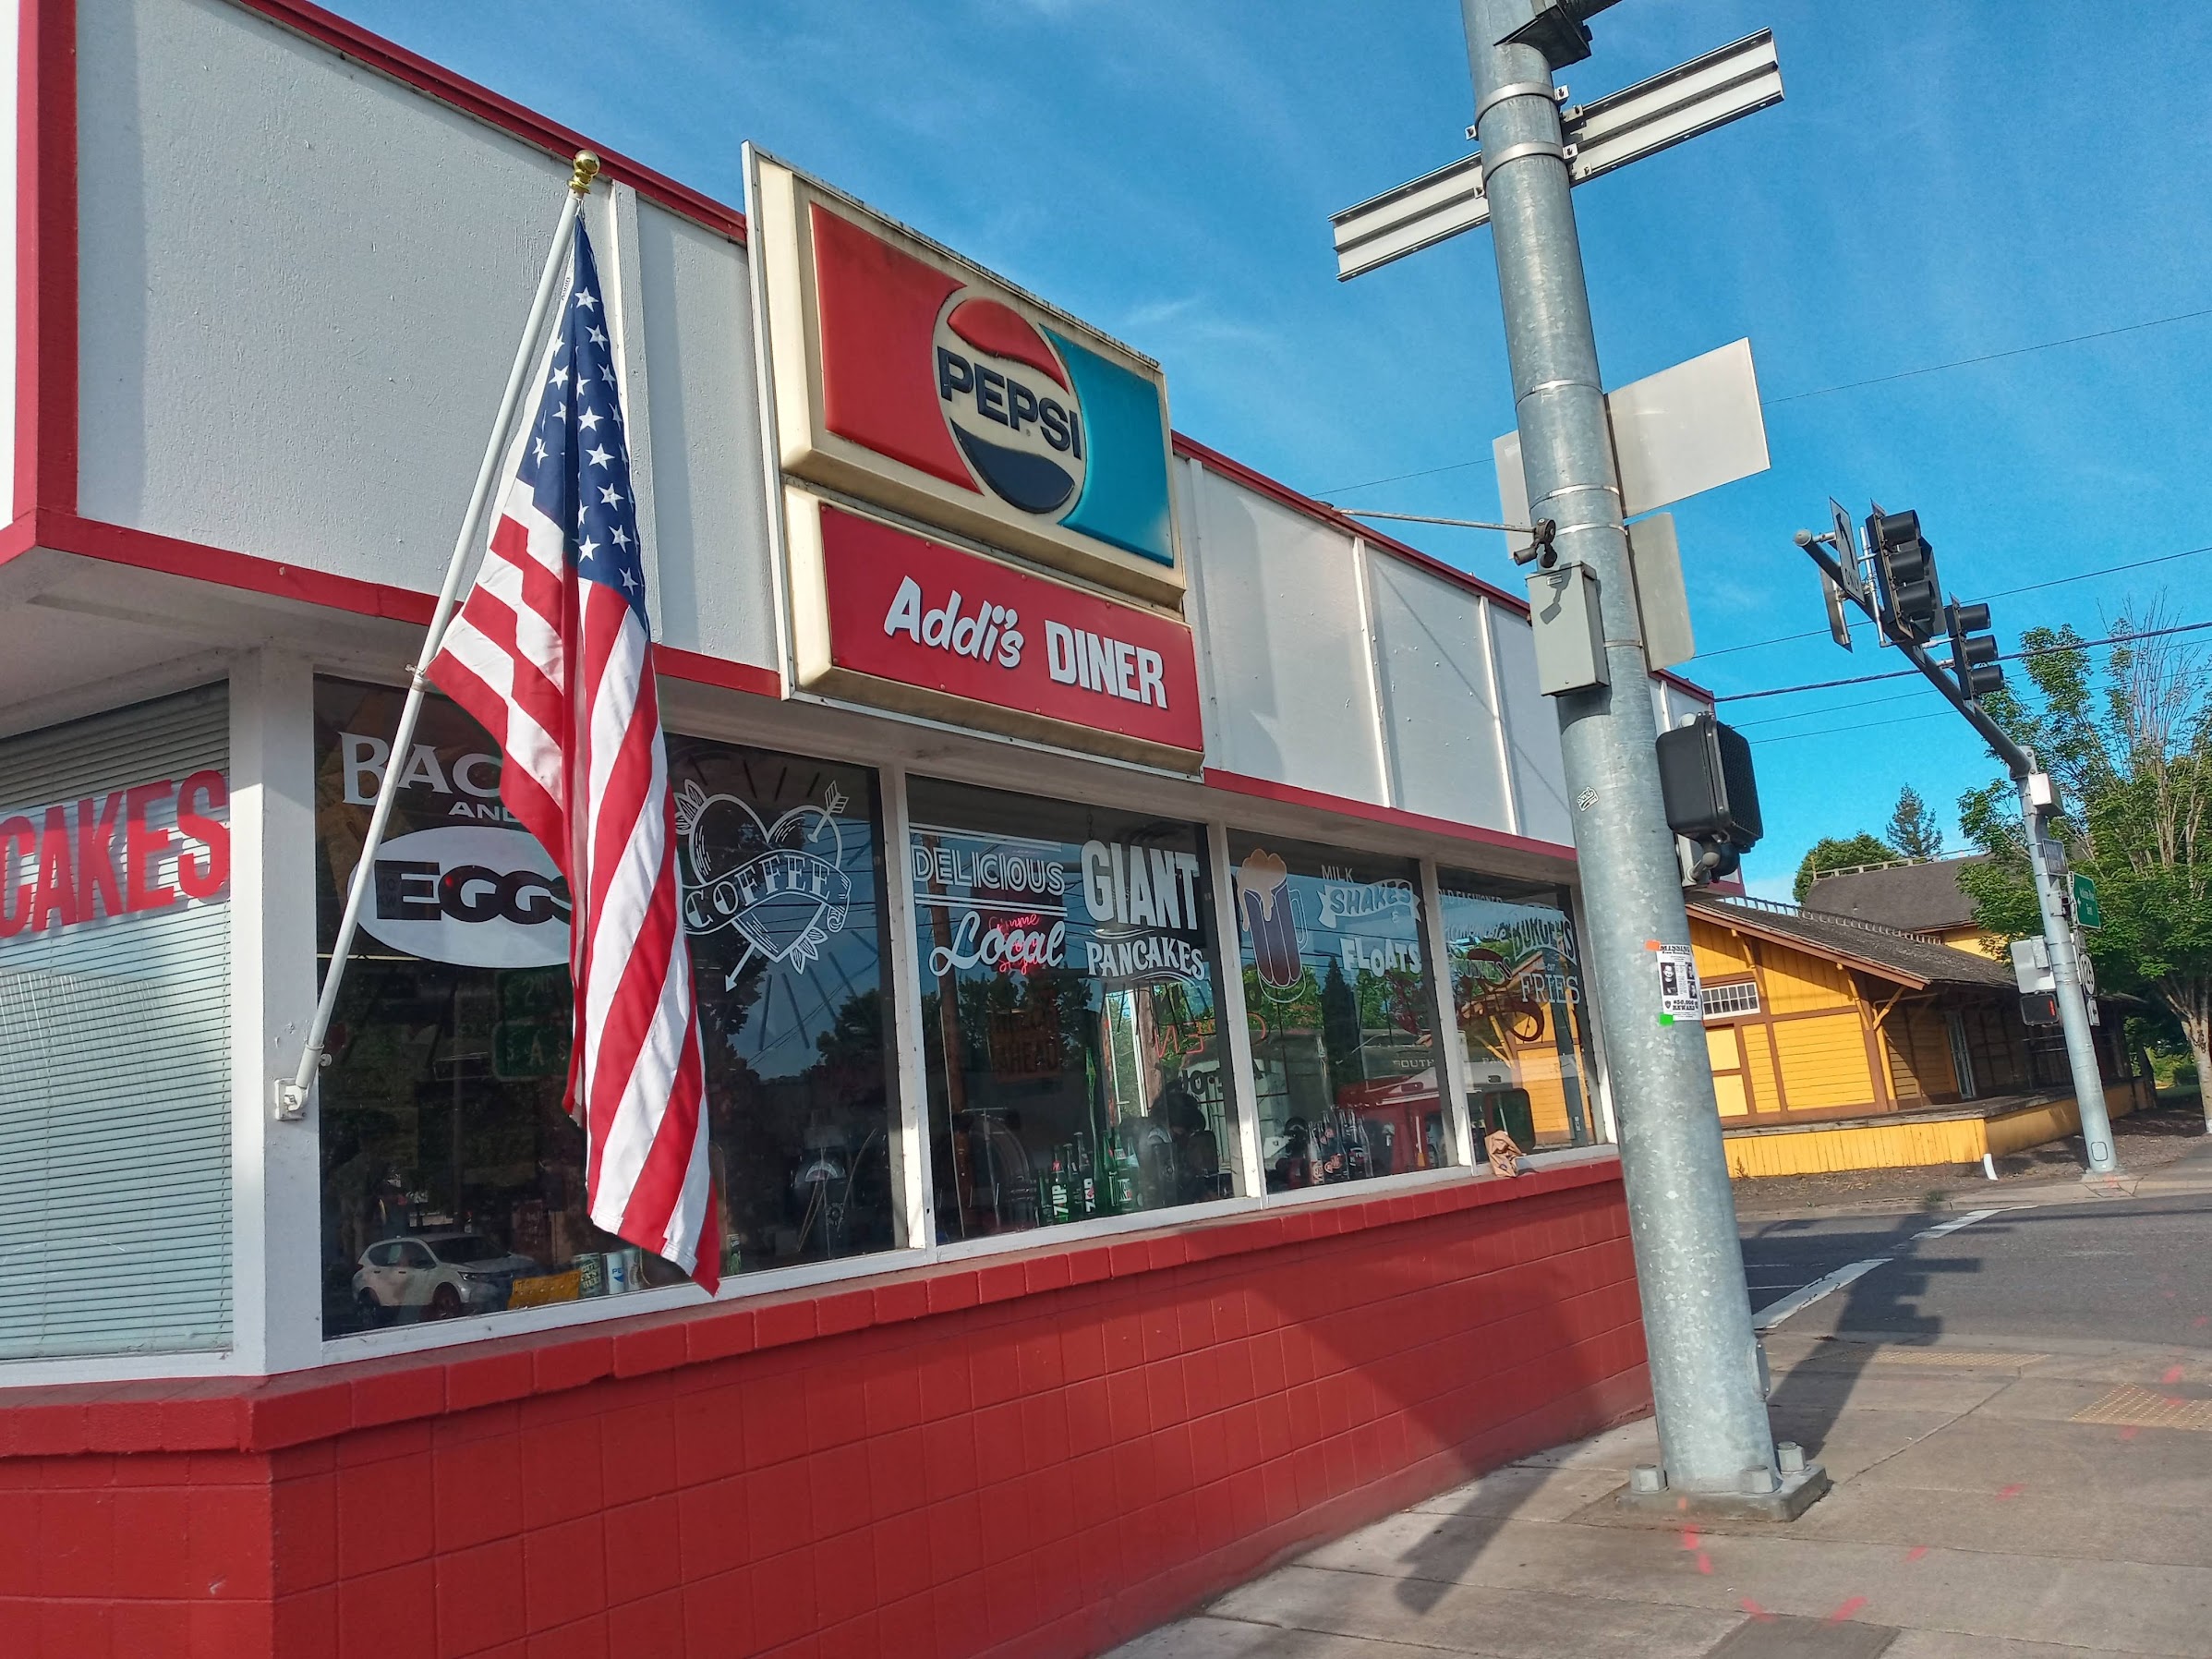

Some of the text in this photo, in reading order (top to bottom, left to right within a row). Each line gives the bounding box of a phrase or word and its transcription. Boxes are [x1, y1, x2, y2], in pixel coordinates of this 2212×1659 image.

[937, 345, 1082, 460] PEPSI
[883, 575, 1168, 709] Addi's DINER
[0, 769, 230, 938] CAKES
[911, 844, 1065, 896] DELICIOUS
[1321, 865, 1354, 883] MILK
[685, 854, 830, 927] COFFEE
[1081, 840, 1200, 930] GIANT
[1330, 880, 1412, 914] SHAKES
[929, 911, 1065, 976] Local
[1084, 936, 1205, 981] PANCAKES
[1339, 937, 1422, 977] FLOATS
[1518, 973, 1580, 1004] FRIES
